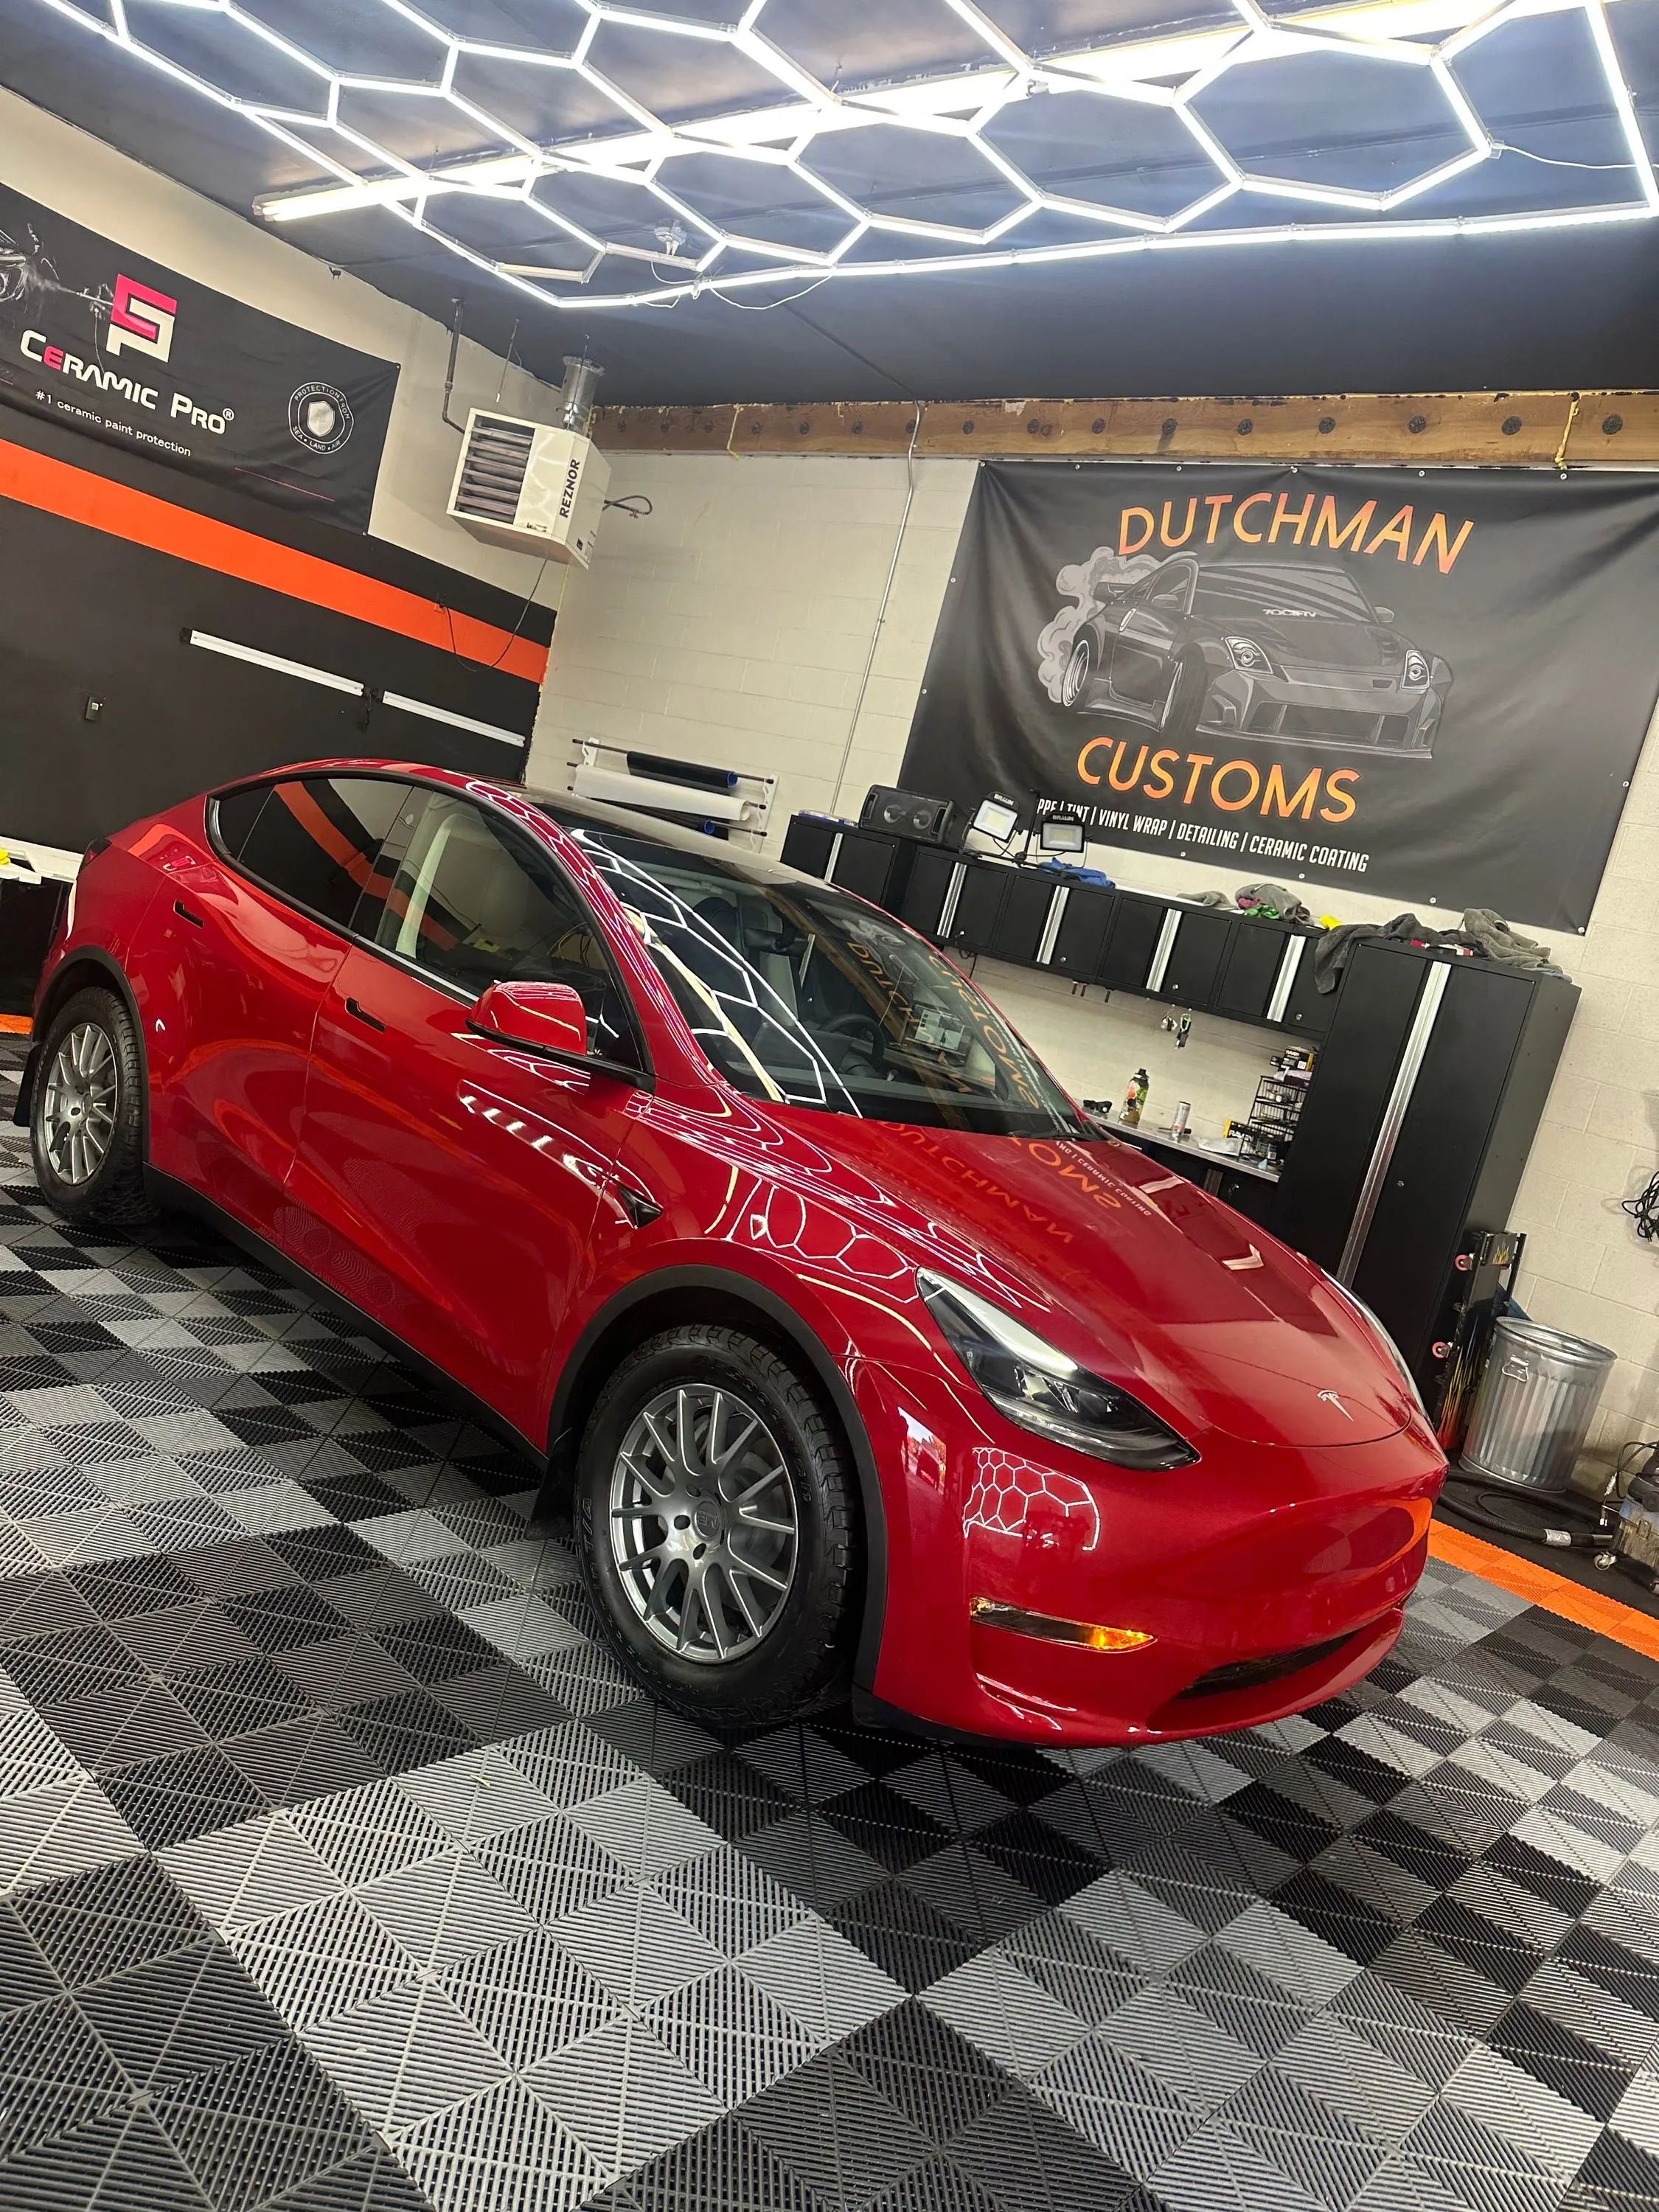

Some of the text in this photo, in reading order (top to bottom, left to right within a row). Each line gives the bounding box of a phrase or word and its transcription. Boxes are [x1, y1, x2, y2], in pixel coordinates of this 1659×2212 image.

[20, 330, 159, 410] CERAMIC
[294, 385, 350, 419] PROTECTION FROM
[35, 390, 191, 457] #1 ceramic paint protection
[293, 425, 341, 451] SEA LAND AIR
[559, 459, 580, 518] REZNOR
[1118, 492, 1475, 575] DUTCHMAN
[993, 793, 1015, 806] BRAUN
[1077, 736, 1361, 824] CUSTOMS
[1067, 803, 1090, 823] TINT
[1099, 809, 1130, 831] VINYL
[1132, 815, 1167, 837] WRAP
[1177, 822, 1239, 849] DETAILING
[1249, 835, 1307, 861] CERAMIC
[1309, 845, 1370, 872] COATING
